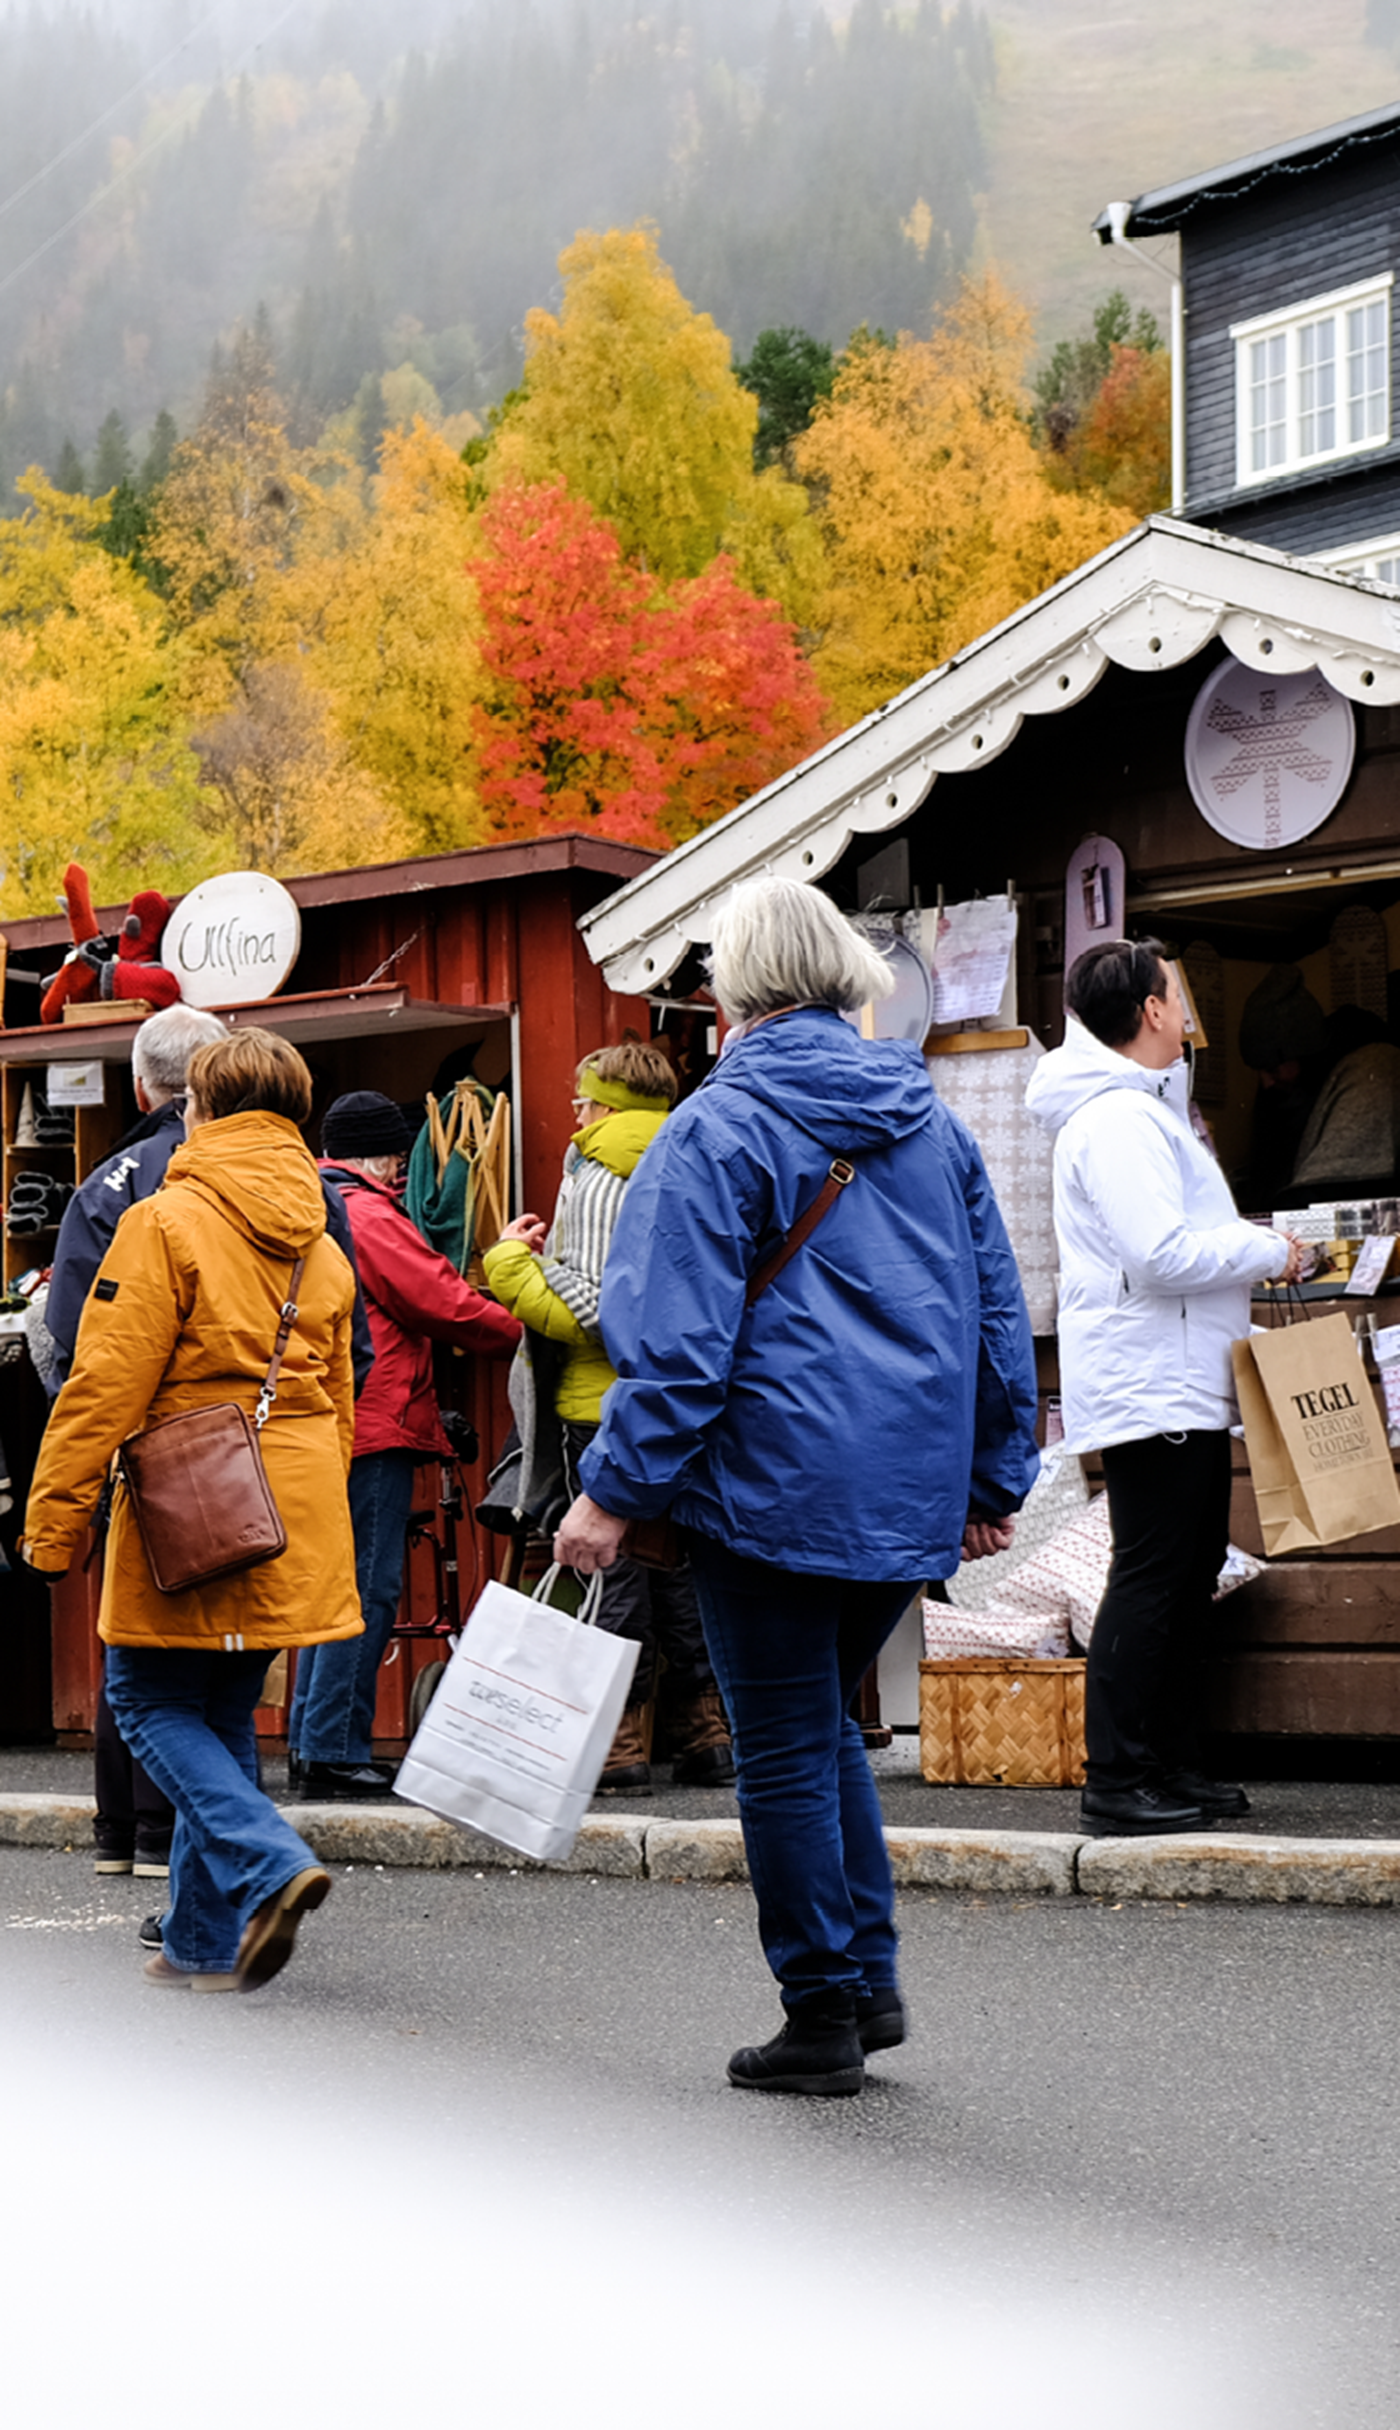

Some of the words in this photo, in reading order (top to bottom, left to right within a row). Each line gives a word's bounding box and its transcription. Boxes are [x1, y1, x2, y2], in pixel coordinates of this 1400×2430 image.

[178, 916, 277, 976] Ullfina
[1290, 1382, 1360, 1420] TEGEL
[1302, 1411, 1364, 1441] EVERYDAY
[1308, 1429, 1371, 1459] CLOTHING
